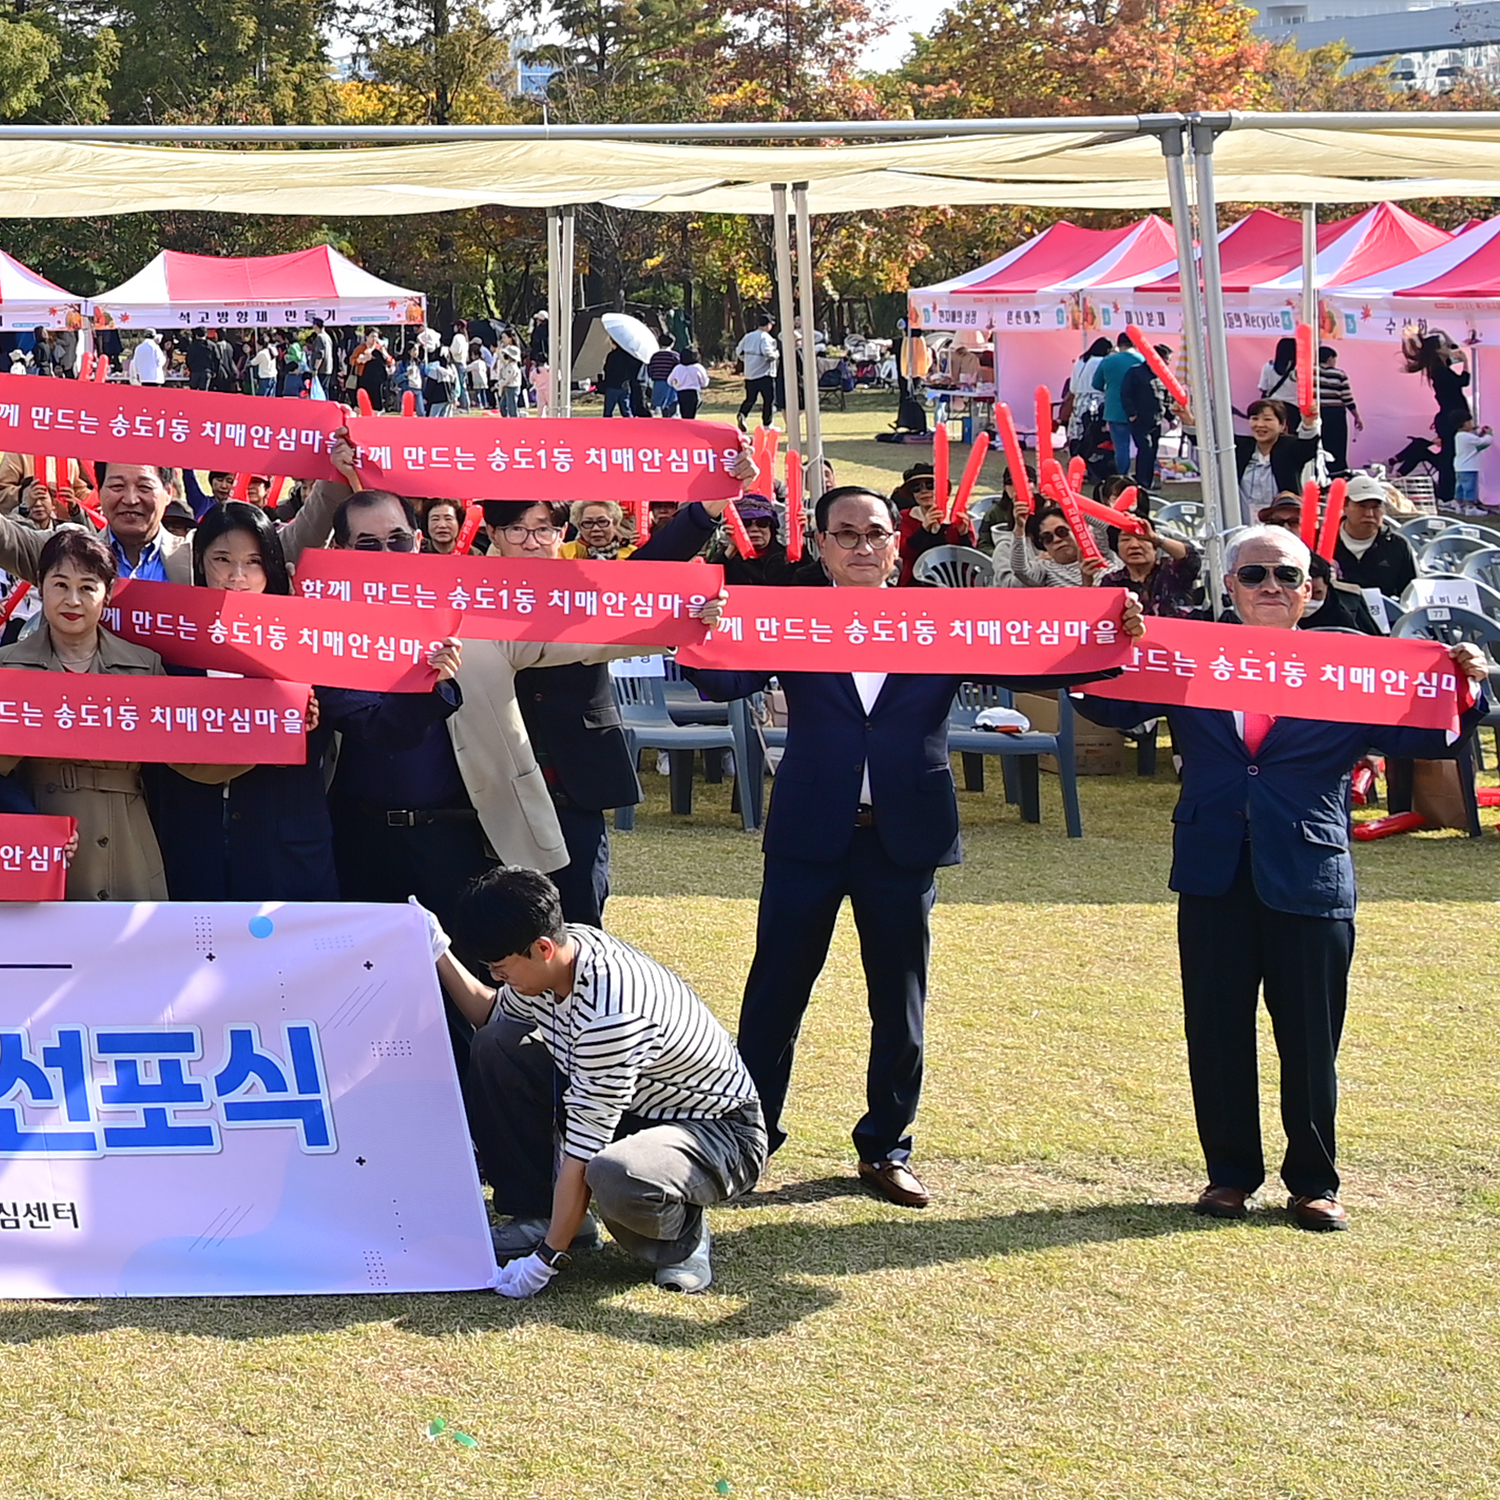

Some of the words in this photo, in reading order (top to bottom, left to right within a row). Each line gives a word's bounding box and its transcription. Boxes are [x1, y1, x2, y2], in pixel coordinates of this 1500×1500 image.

[178, 310, 268, 323] 석고방향제
[285, 309, 336, 322] 만들기
[1243, 312, 1281, 330] Recycle
[31, 406, 99, 434] 만드는
[108, 413, 190, 442] 송도1동
[403, 446, 476, 470] 만드는
[486, 447, 574, 472] 송도1동
[585, 447, 738, 472] 치매안심마을
[301, 579, 350, 601] 함께
[363, 582, 437, 609] 만드는
[447, 586, 536, 613] 송도1동
[548, 589, 705, 618] 치매안심마을
[99, 604, 120, 633] 께
[131, 610, 198, 640] 만드는
[207, 619, 288, 650] 송도1동
[716, 615, 742, 641] 께
[755, 617, 833, 642] 만드는
[843, 619, 937, 645] 송도1동
[949, 619, 1116, 645] 치매안심마을
[1208, 654, 1307, 687] 송도1동
[1319, 664, 1455, 697] 치매안심
[53, 703, 139, 731] 송도1동
[150, 706, 303, 733] 치매안심마을
